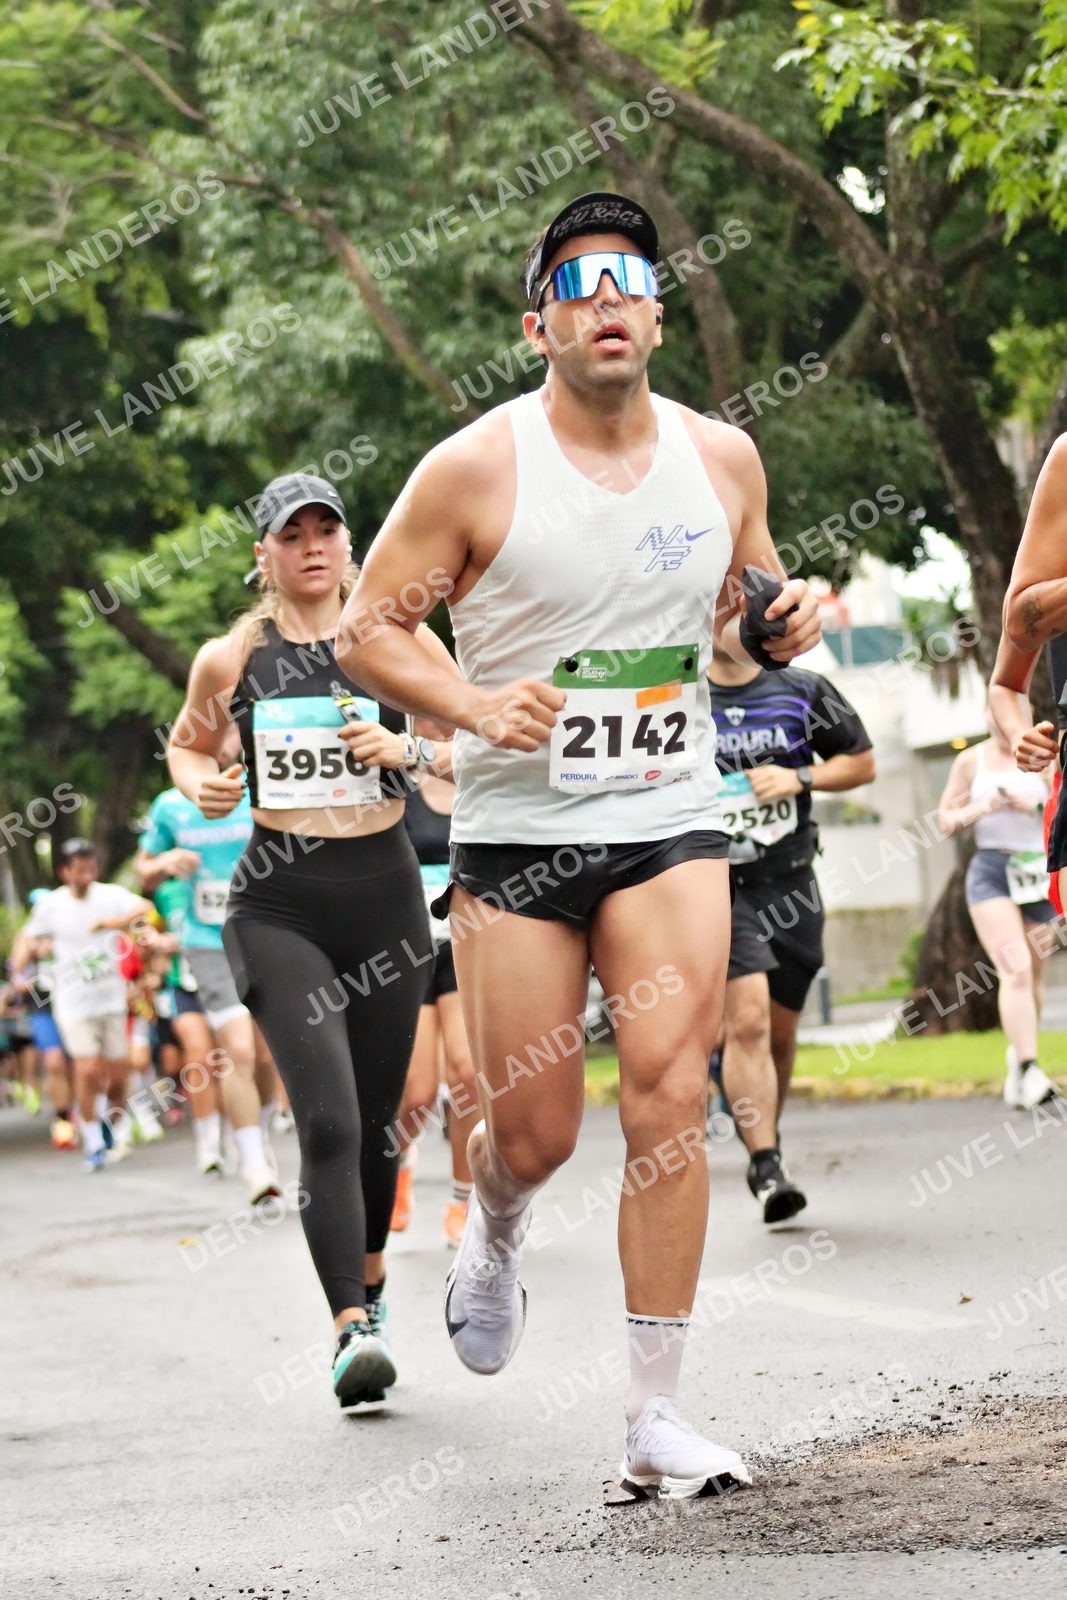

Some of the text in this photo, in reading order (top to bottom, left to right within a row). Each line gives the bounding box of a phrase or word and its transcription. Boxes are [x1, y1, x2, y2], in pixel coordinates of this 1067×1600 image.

[591, 207, 643, 225] RACE
[562, 711, 688, 758] 2142
[266, 747, 370, 781] 3956
[560, 773, 598, 781] PERDURA
[722, 799, 791, 829] 2520
